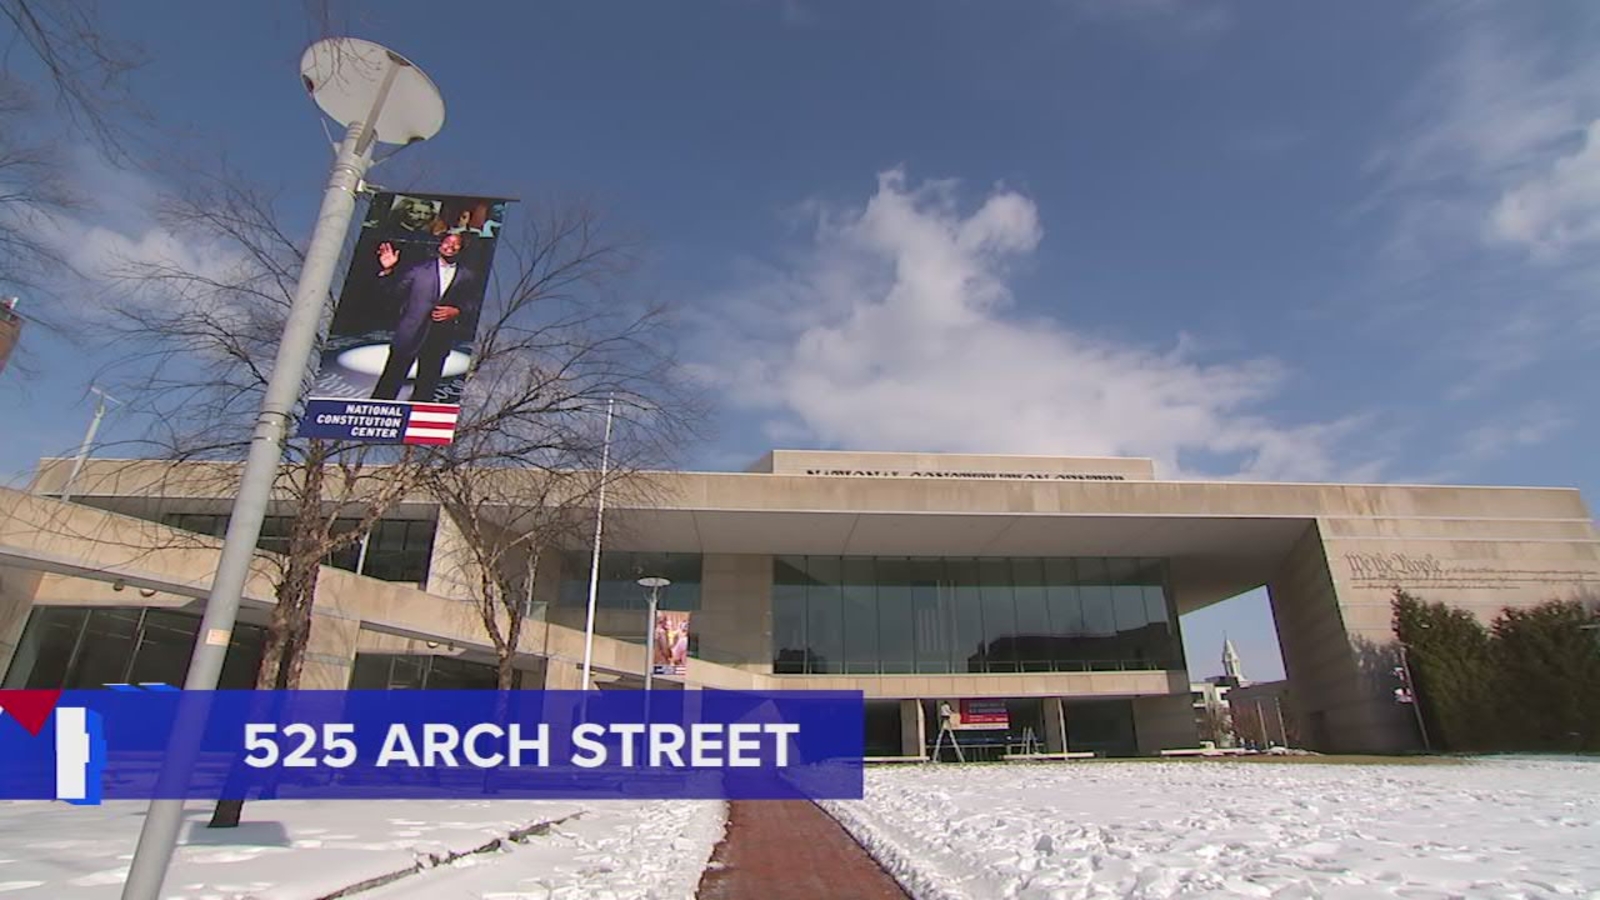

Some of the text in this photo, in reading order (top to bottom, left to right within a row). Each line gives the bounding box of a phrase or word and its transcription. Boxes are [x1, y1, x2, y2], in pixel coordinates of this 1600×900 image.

[345, 404, 403, 417] NATIONAL
[316, 414, 402, 428] CONSTITUTION
[350, 426, 398, 438] CENTER
